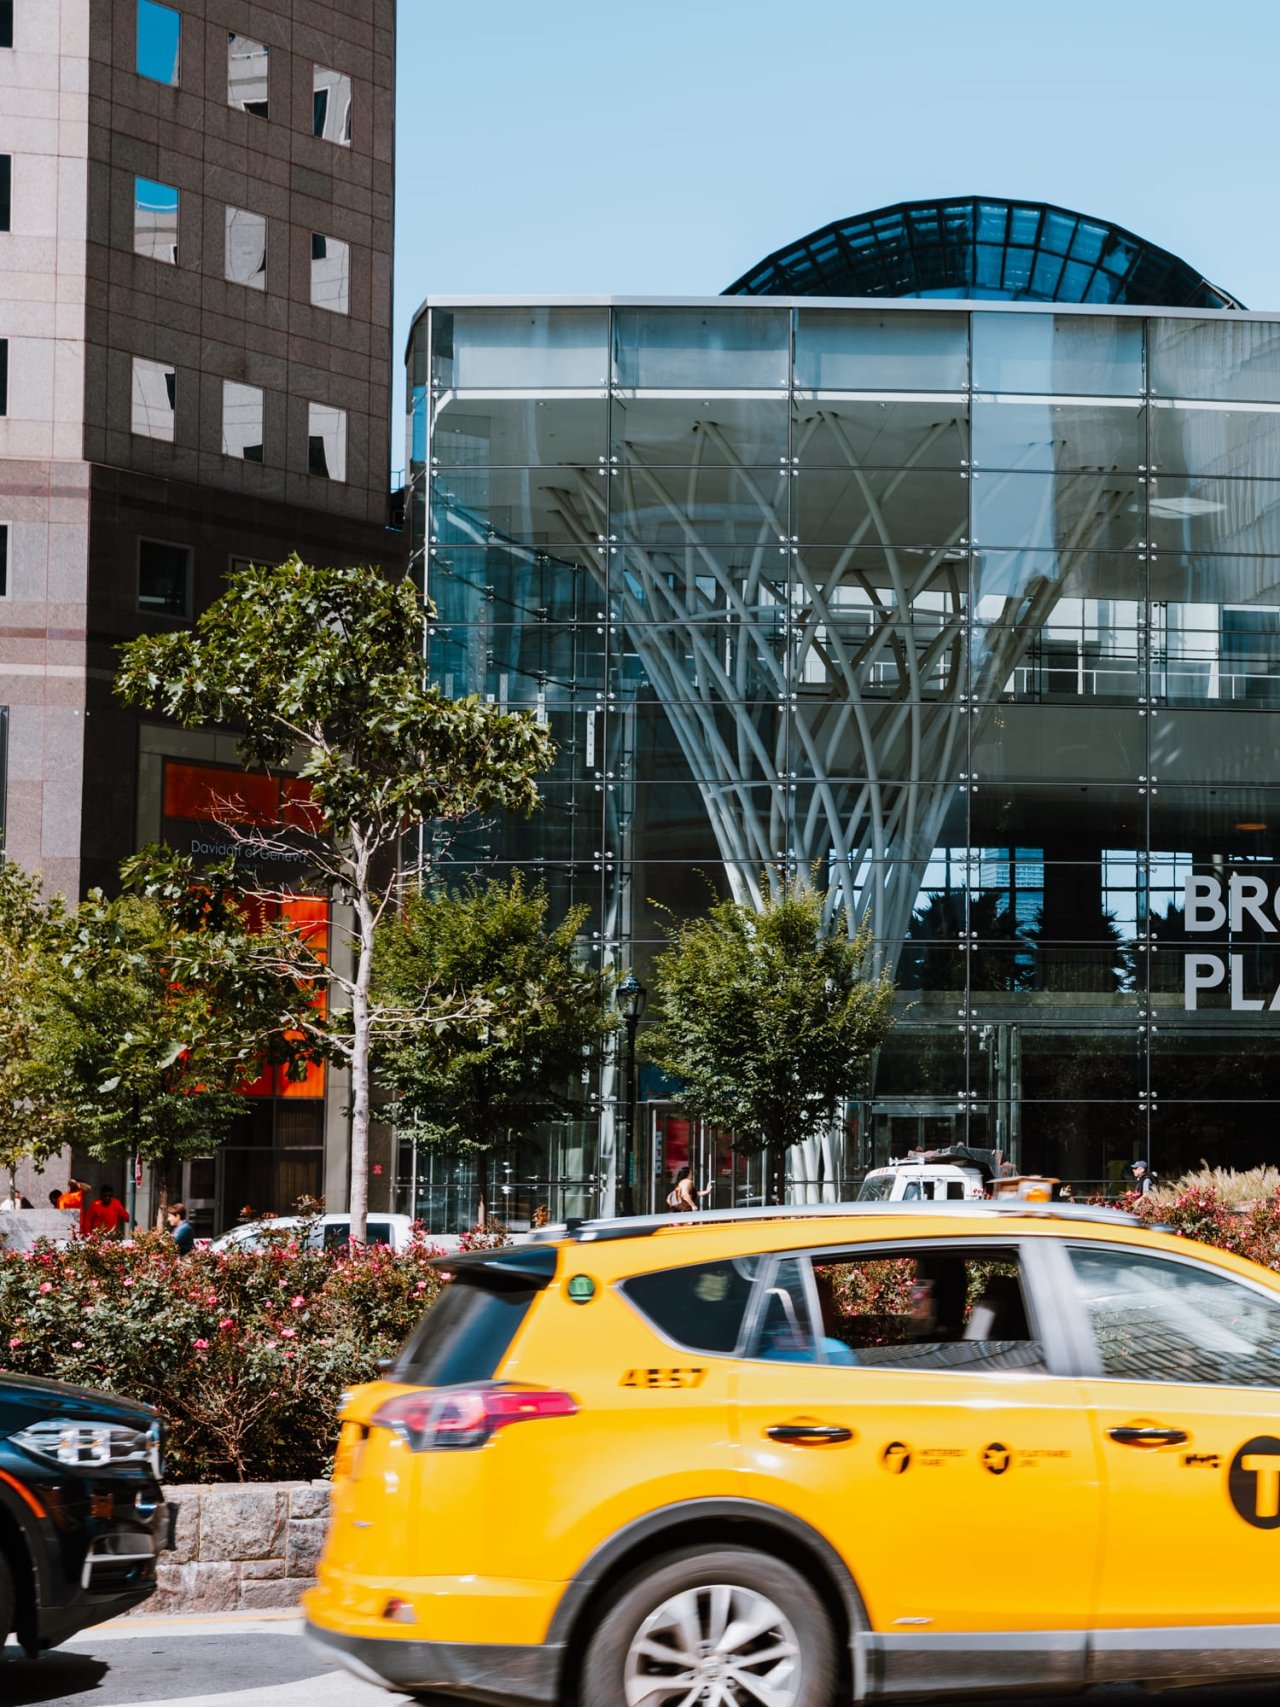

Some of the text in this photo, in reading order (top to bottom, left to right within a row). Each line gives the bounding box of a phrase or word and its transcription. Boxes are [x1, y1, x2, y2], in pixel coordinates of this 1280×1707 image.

[191, 840, 307, 863] Davidoff of Geneva
